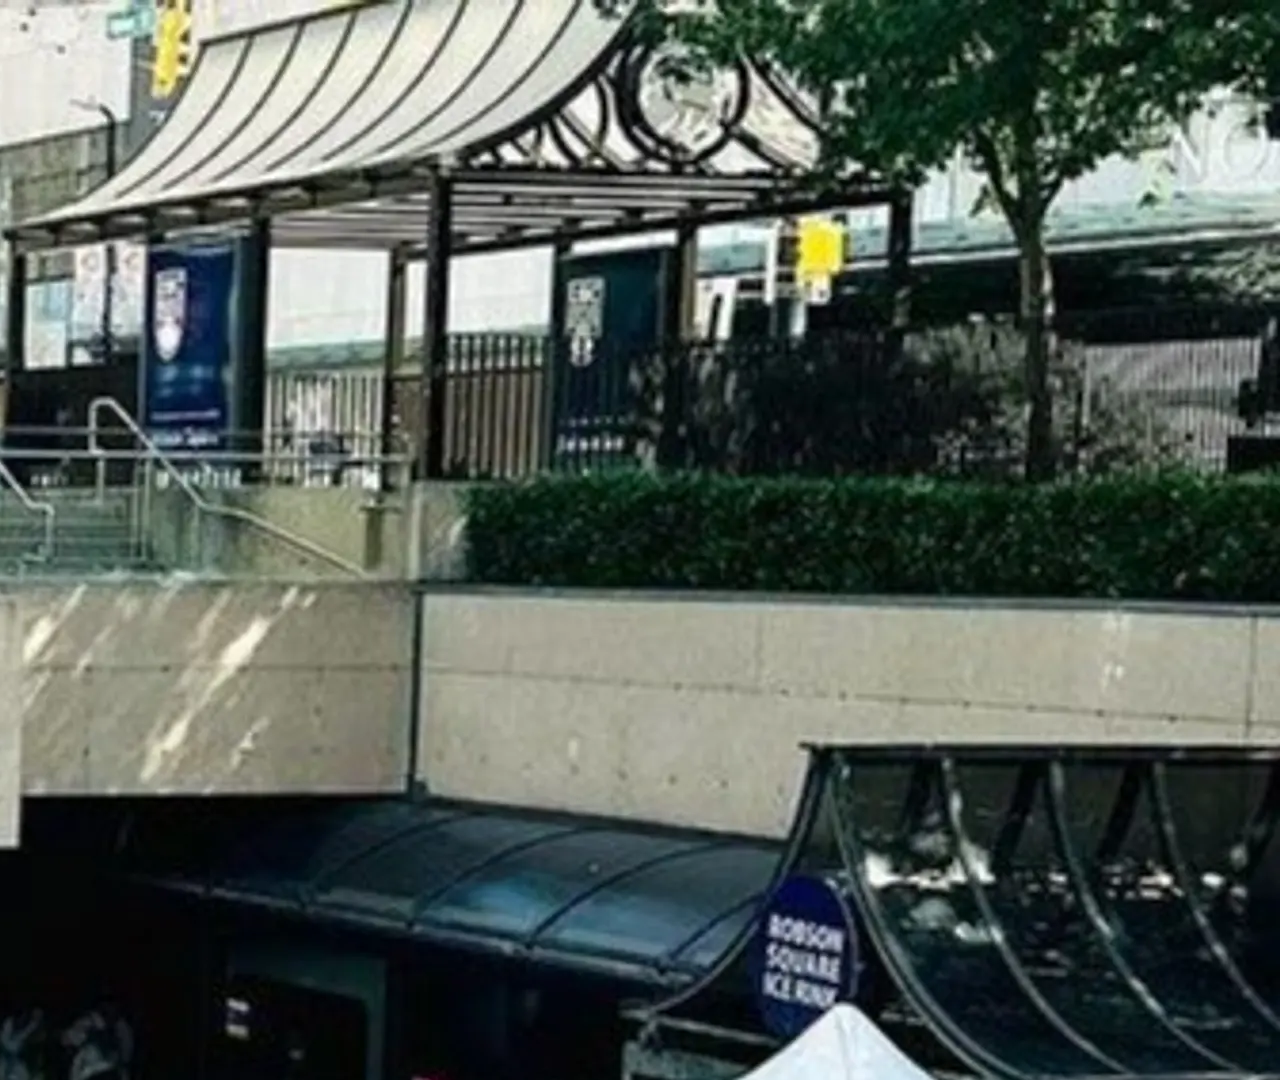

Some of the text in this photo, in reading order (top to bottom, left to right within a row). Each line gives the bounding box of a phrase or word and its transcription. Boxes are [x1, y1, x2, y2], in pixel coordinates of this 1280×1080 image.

[768, 913, 843, 953] ROBSON
[766, 942, 840, 983] SQUARE
[763, 972, 838, 1008] ICE RINK
